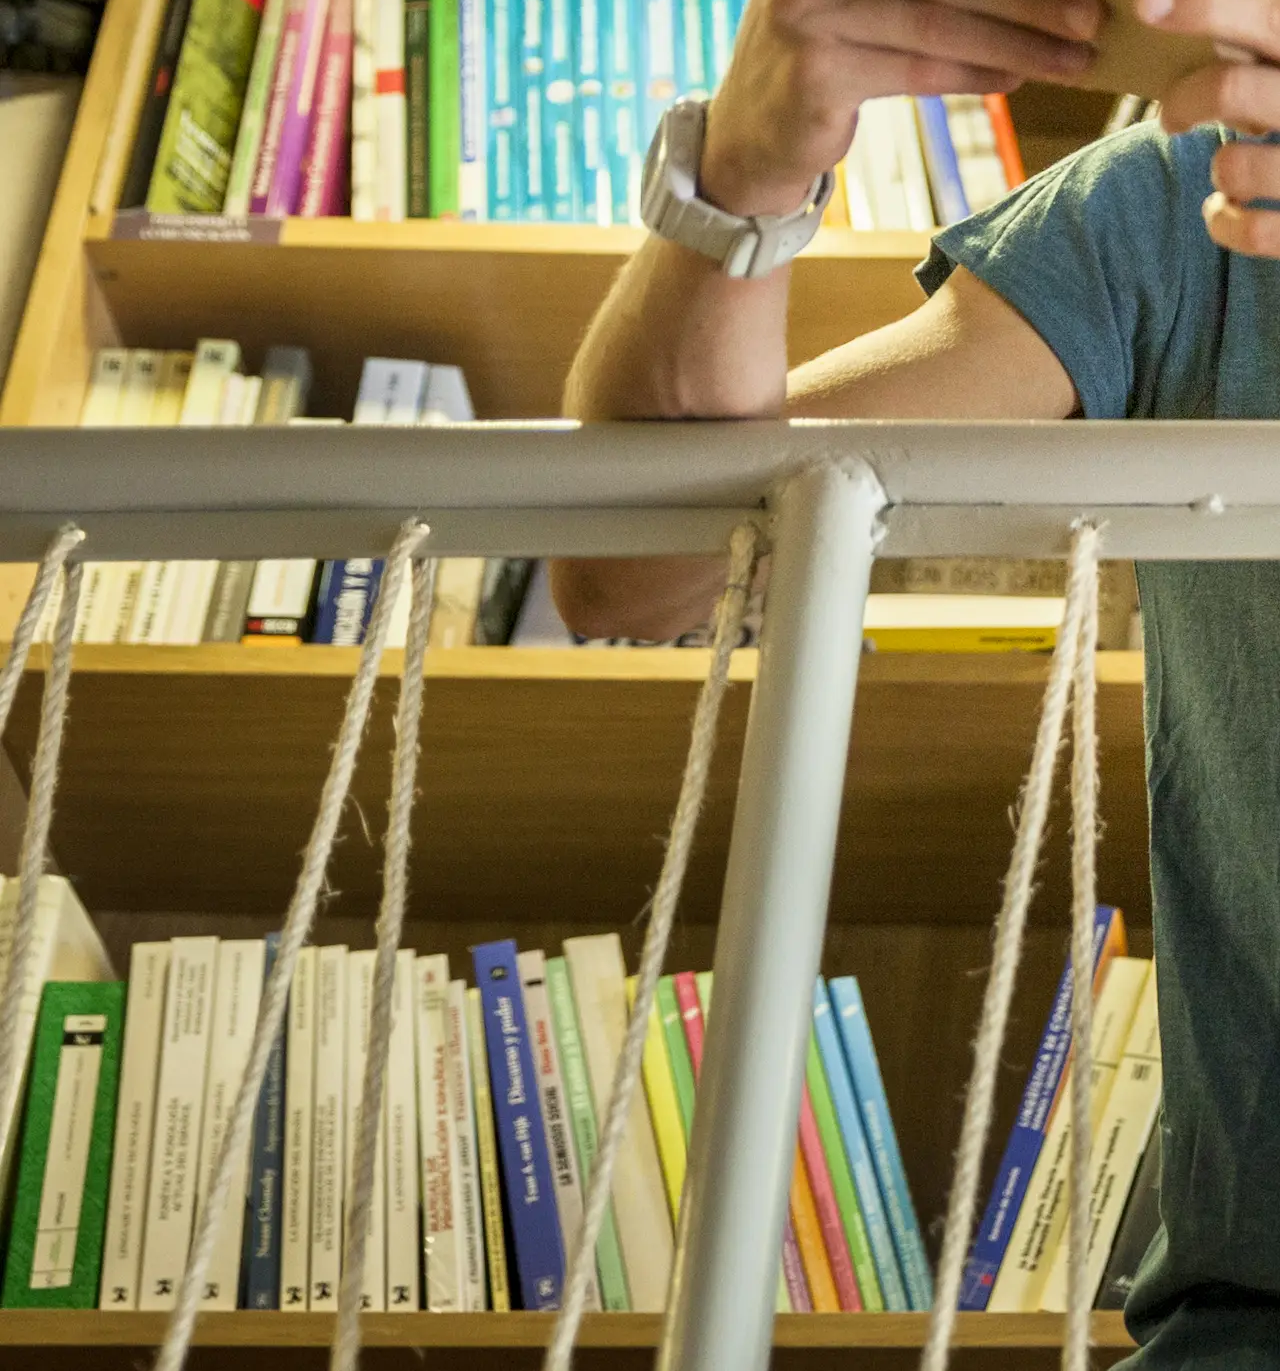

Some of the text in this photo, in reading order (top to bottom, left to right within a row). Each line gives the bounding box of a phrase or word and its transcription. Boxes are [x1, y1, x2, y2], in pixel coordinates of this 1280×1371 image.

[490, 993, 526, 1105] Discurso y poder
[425, 1157, 438, 1232] MANUAL DE
